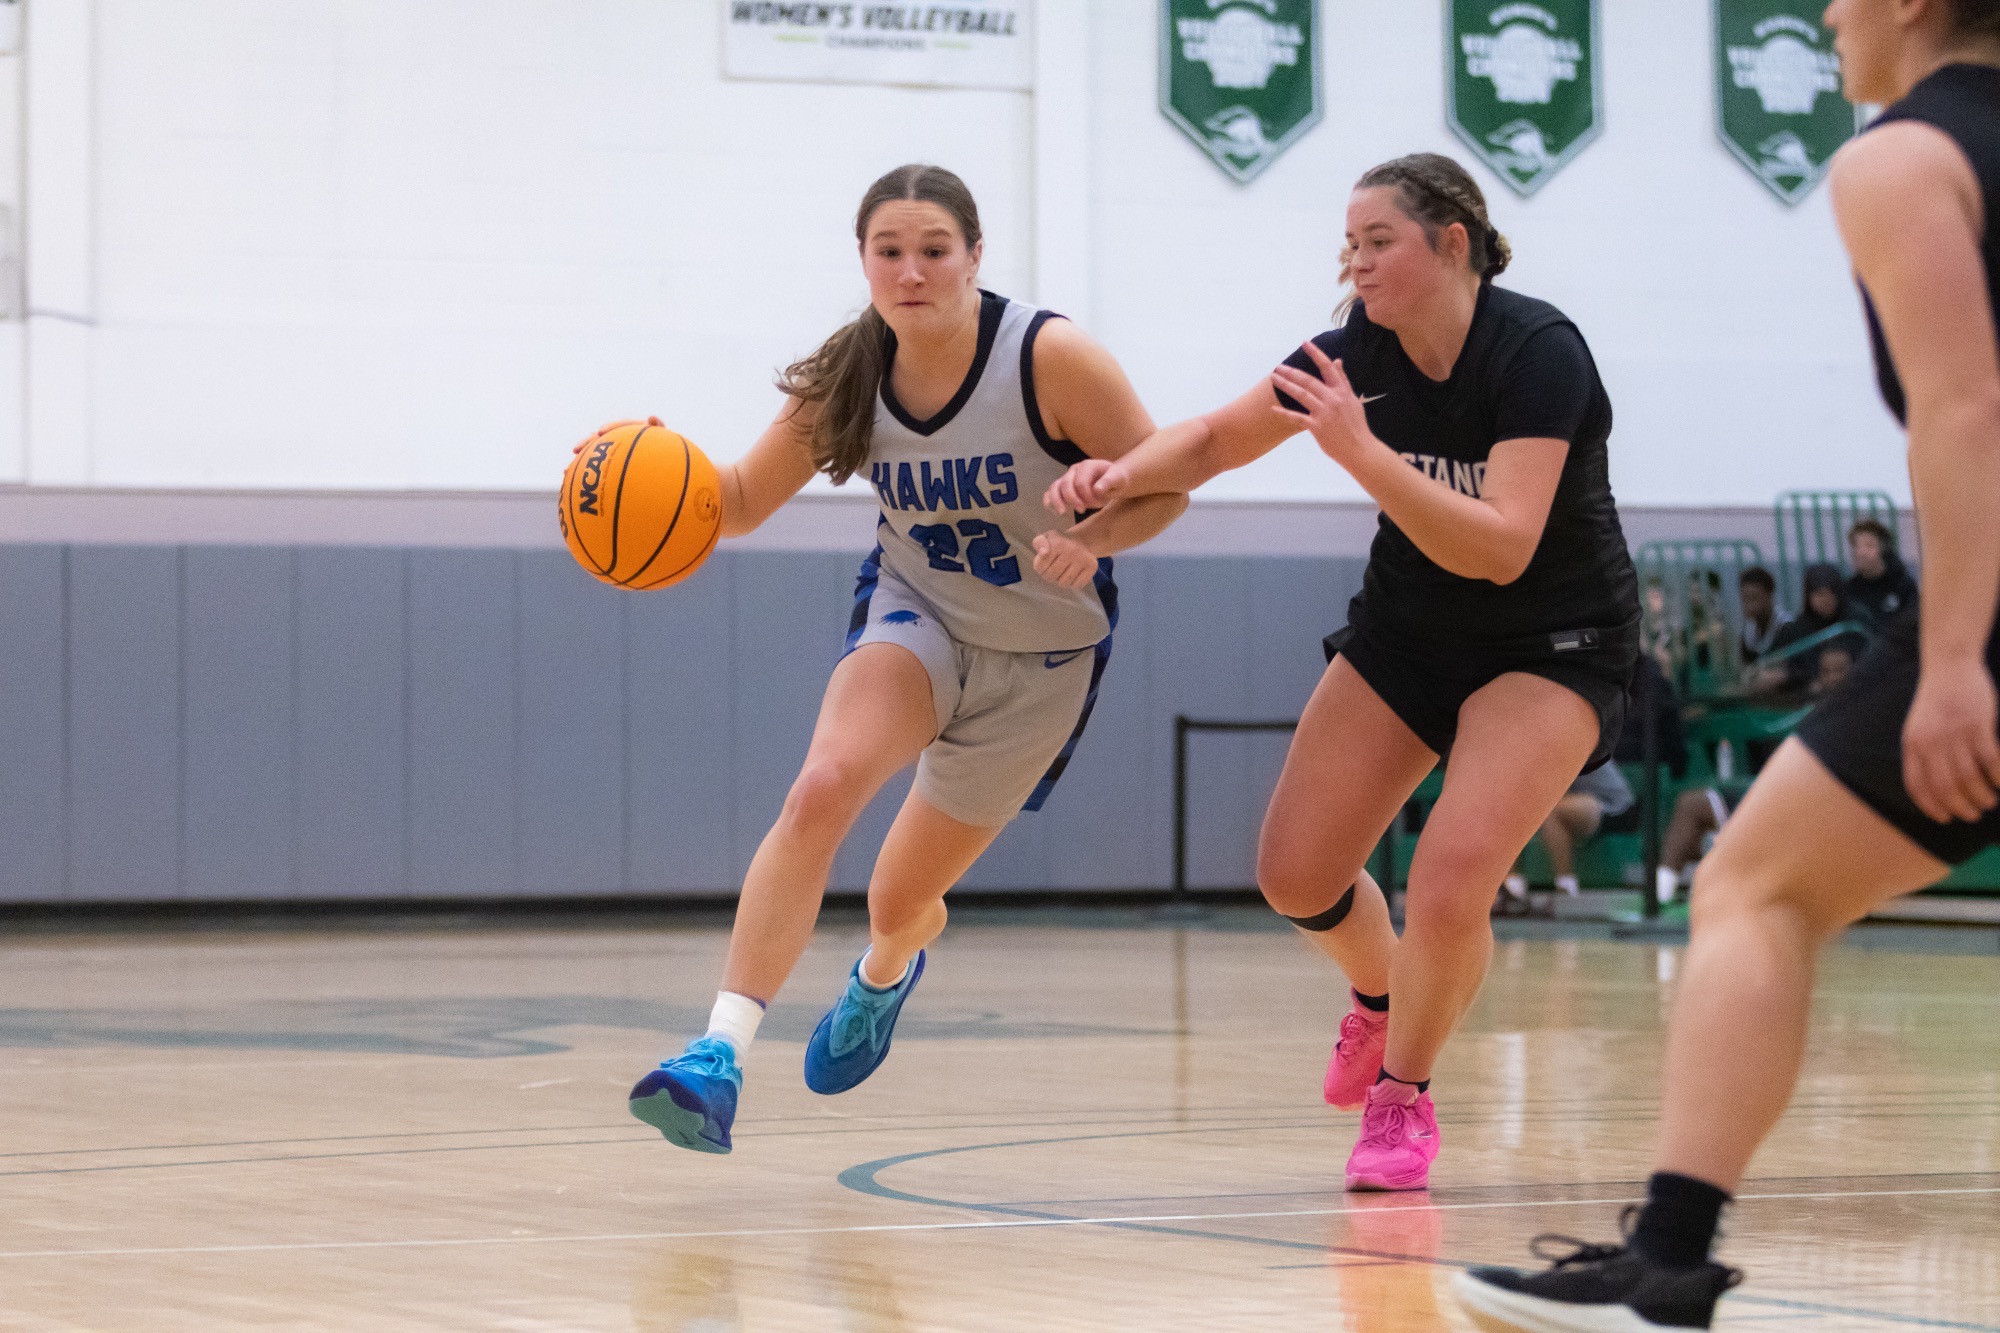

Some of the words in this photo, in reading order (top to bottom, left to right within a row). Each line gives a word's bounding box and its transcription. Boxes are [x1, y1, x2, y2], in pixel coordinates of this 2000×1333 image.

[862, 6, 1015, 35] VOLLEYBALL
[580, 441, 615, 516] NCAA
[871, 453, 1018, 511] HAWKS
[908, 519, 1022, 587] 22
